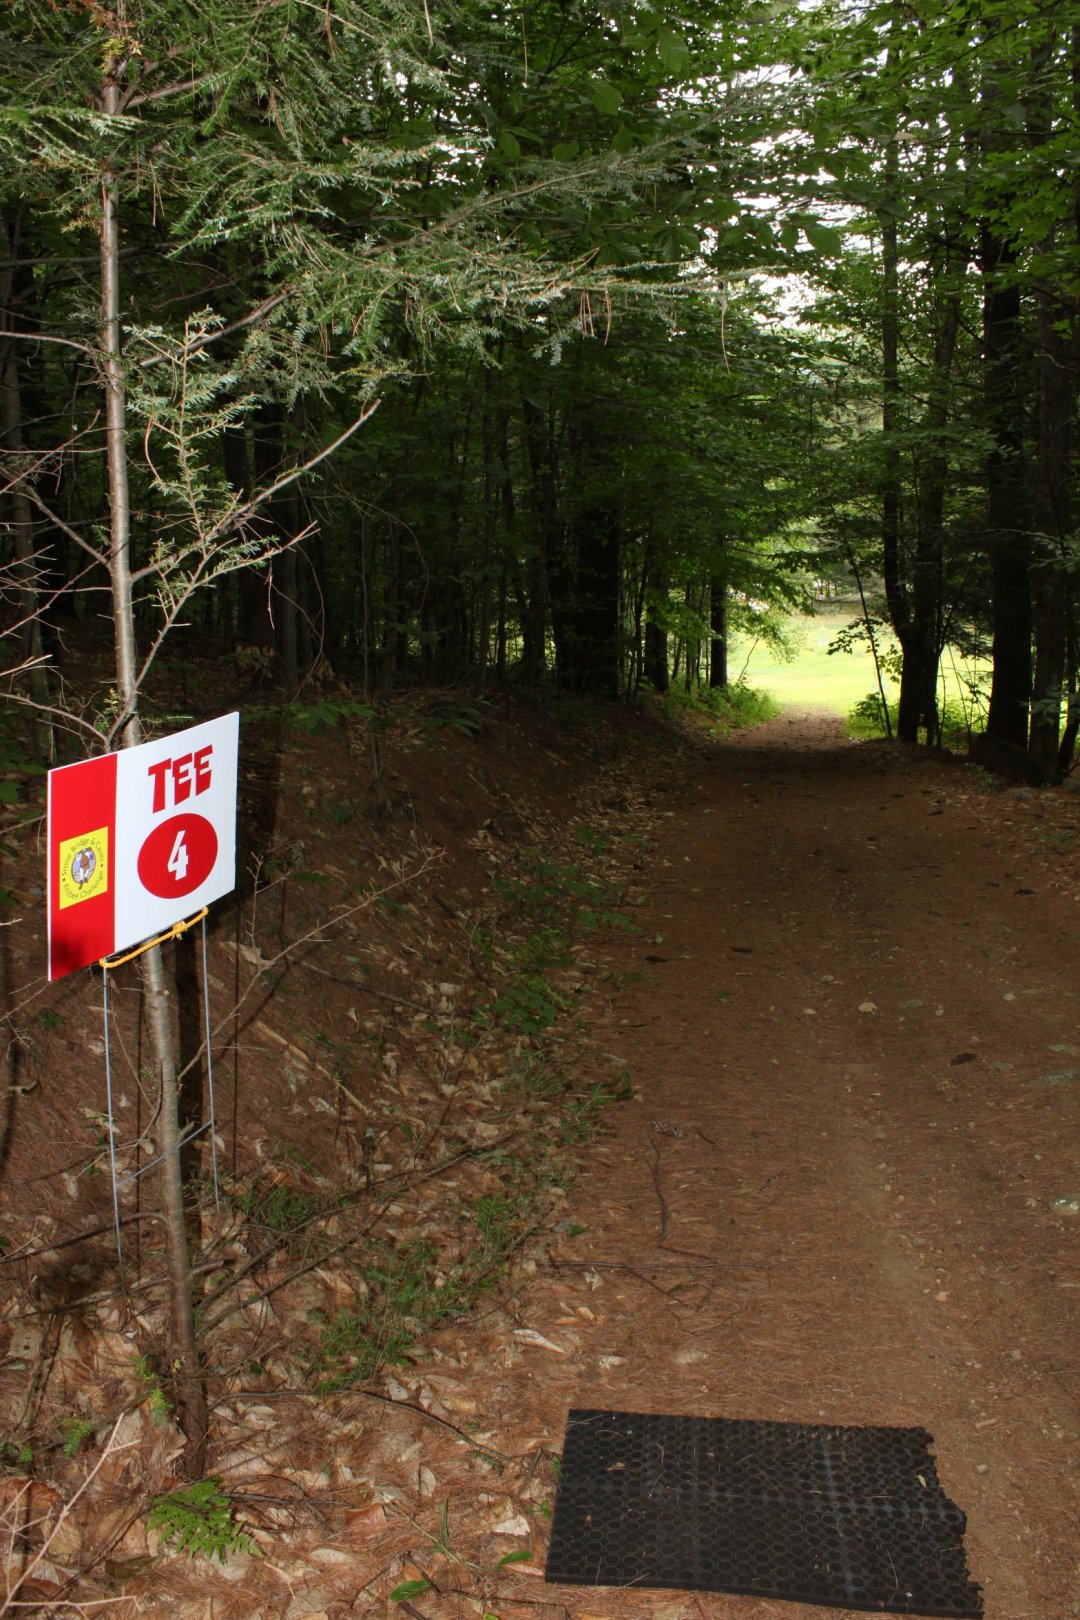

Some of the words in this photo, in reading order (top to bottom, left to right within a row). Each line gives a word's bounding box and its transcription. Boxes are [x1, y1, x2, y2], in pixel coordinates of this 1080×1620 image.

[148, 744, 213, 814] TEE
[61, 853, 72, 876] Stone
[70, 838, 90, 853] Bridge
[167, 829, 189, 881] 4
[63, 883, 79, 900] Frisbee
[80, 870, 104, 899] Challenge
